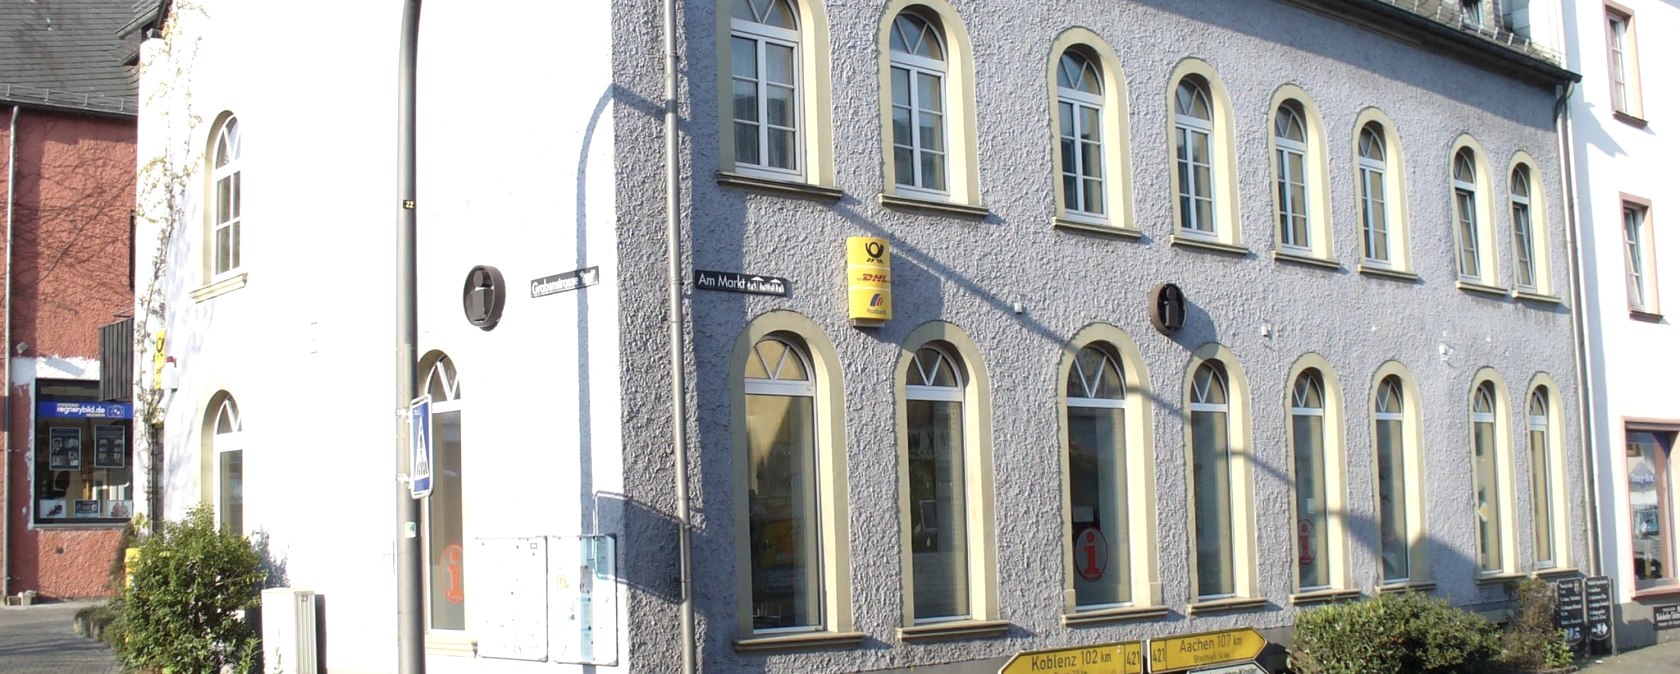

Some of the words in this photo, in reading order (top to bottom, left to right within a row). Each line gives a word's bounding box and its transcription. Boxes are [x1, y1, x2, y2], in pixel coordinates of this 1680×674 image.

[698, 272, 716, 287] Am
[718, 274, 746, 290] Markt
[861, 273, 888, 283] DHL
[1179, 638, 1215, 655] Aachen
[1217, 633, 1232, 649] 107
[1233, 635, 1243, 647] km
[1031, 654, 1077, 672] Koblenz
[1081, 649, 1099, 666] 102
[1101, 651, 1112, 663] km
[1126, 650, 1141, 666] 421
[1152, 647, 1166, 663] 421
